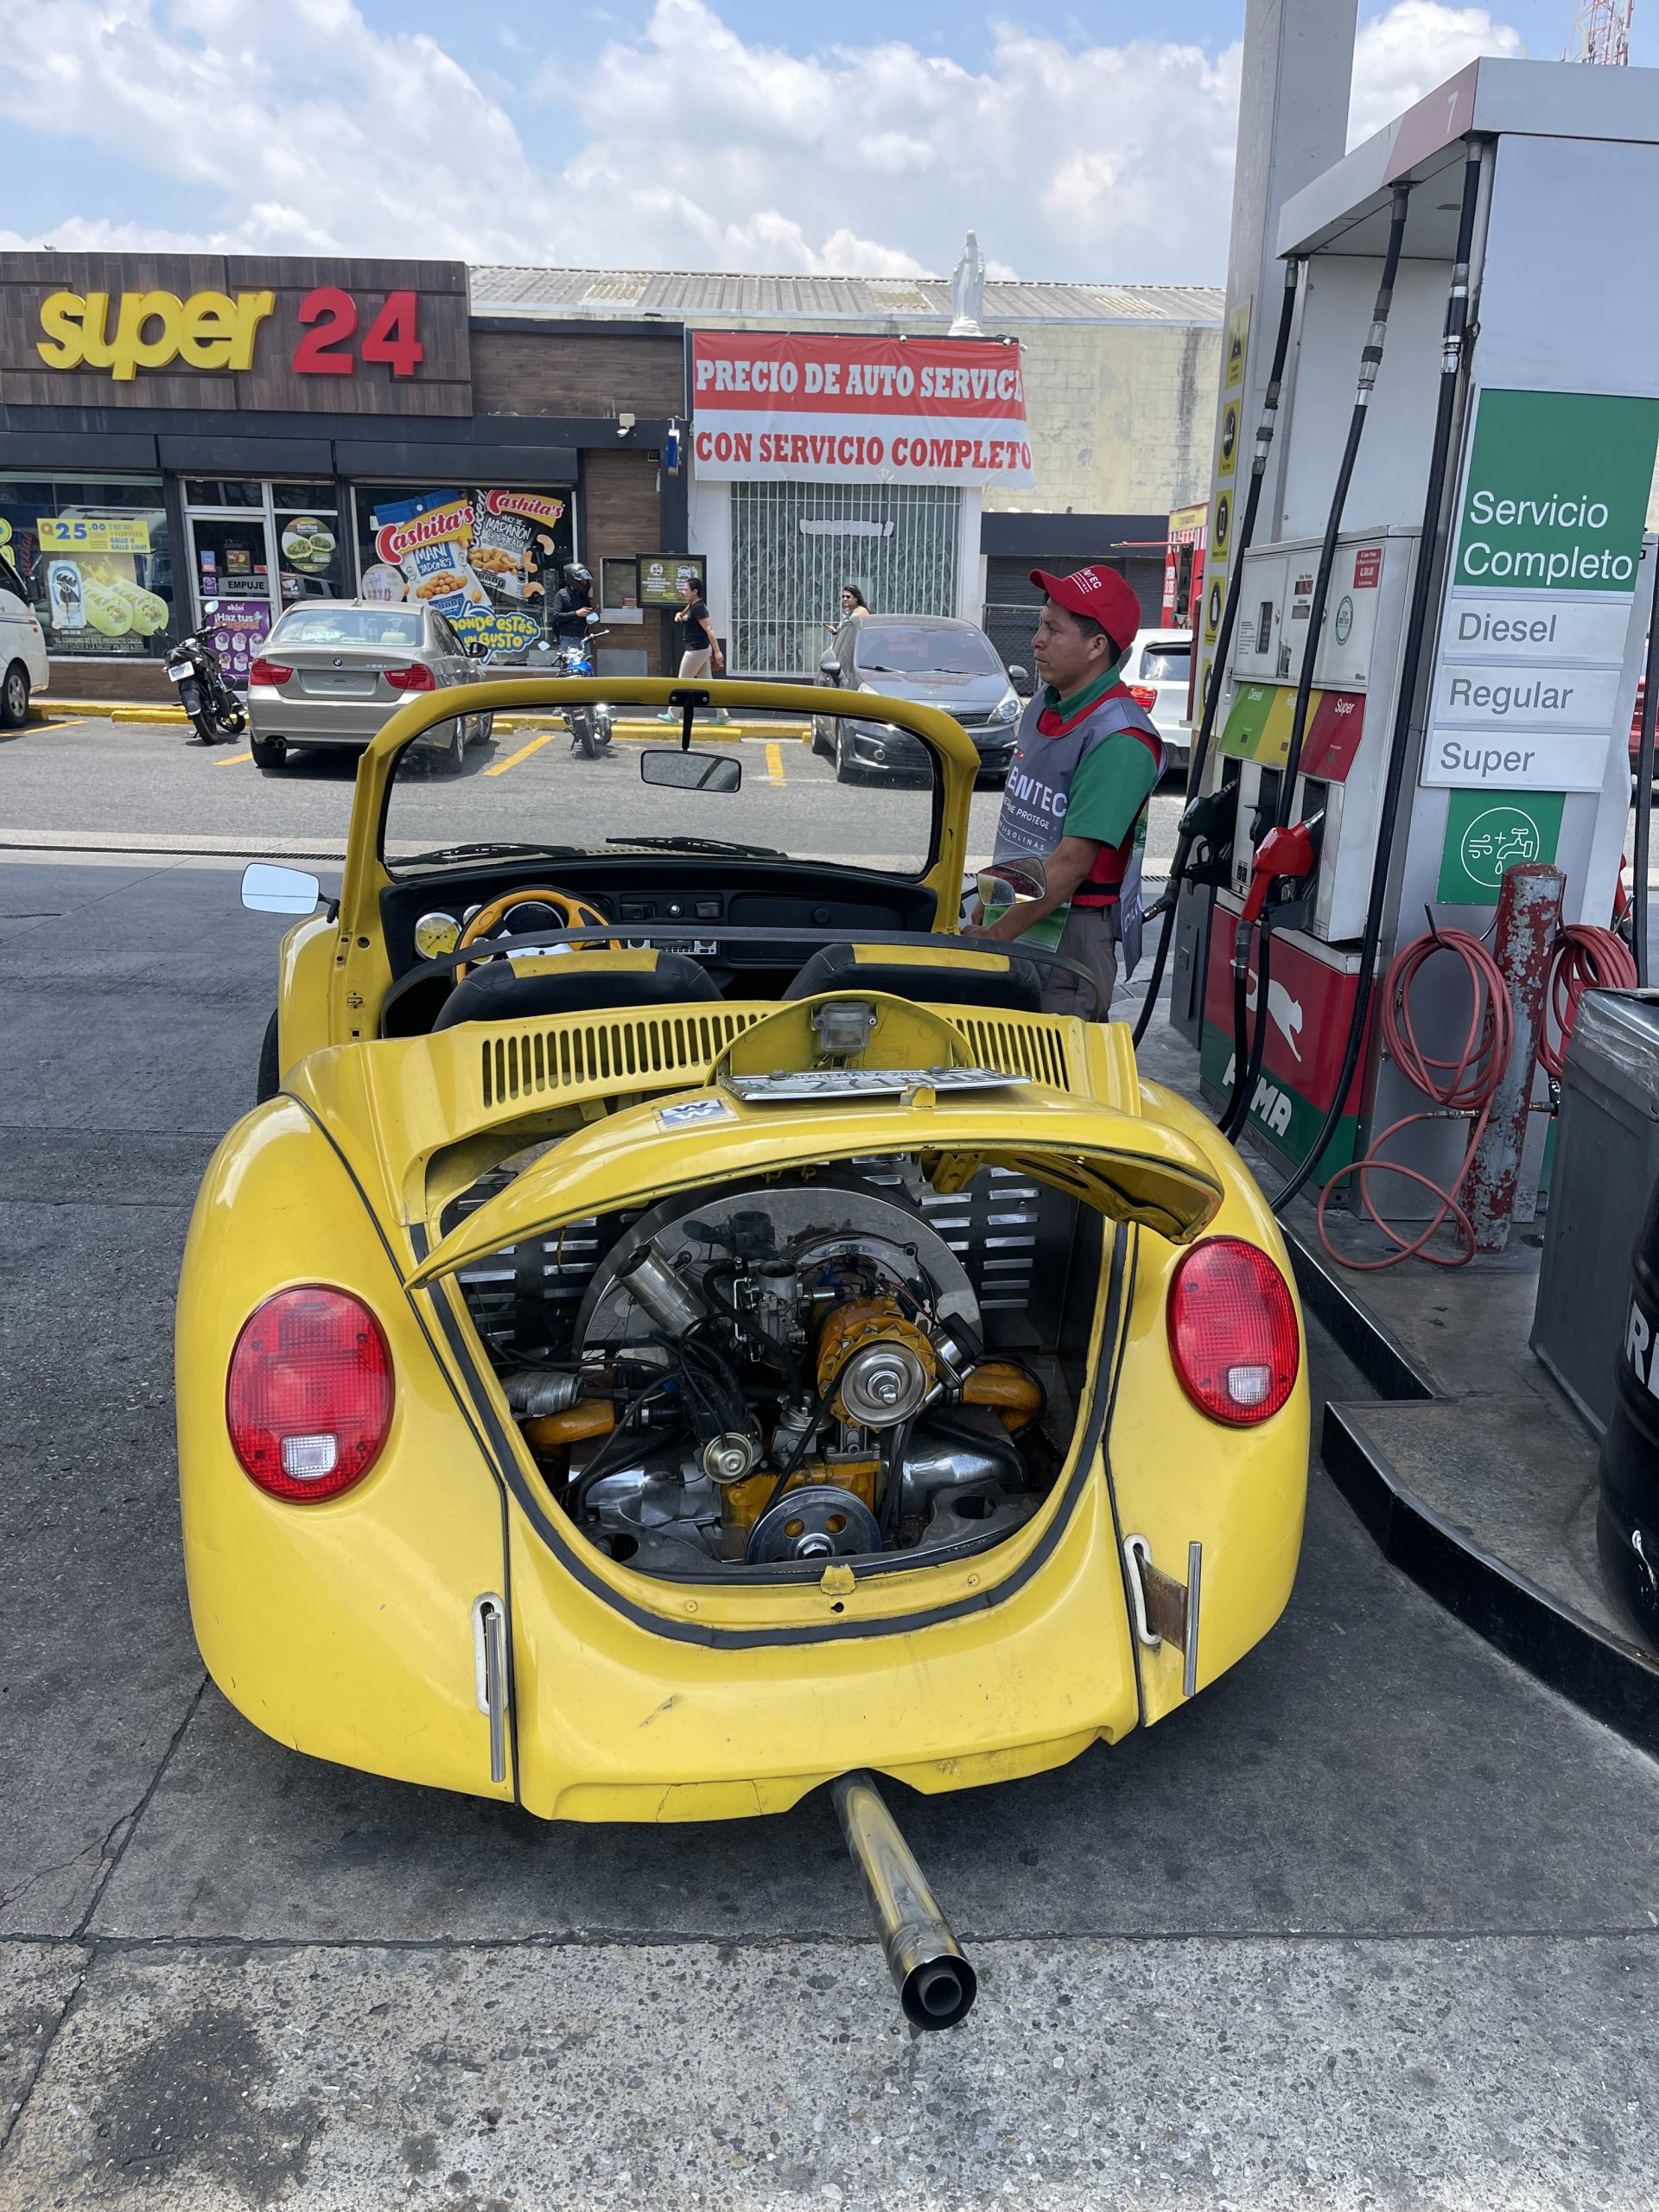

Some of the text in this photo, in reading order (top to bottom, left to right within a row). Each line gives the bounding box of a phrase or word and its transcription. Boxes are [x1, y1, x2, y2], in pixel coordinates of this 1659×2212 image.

[36, 287, 423, 381] super 24
[696, 359, 798, 393] PRECIO
[804, 362, 842, 395] DE
[845, 364, 915, 397] AUTO
[696, 431, 1032, 471] CON SERVICIO COMPLETO
[486, 490, 563, 518] Cashita's
[1470, 490, 1609, 529] Servicio
[375, 505, 474, 566] Cashita's
[1463, 542, 1633, 586] Completo
[227, 581, 264, 589] EMPUJE
[238, 613, 253, 622] tus
[1458, 613, 1557, 642] Diesel
[1248, 688, 1264, 701] Diesel
[1334, 698, 1355, 716] Super
[1449, 678, 1573, 715] Regular
[1440, 741, 1535, 778] Super
[1015, 808, 1050, 830] PROTEGE
[1626, 1300, 1659, 1401] R
